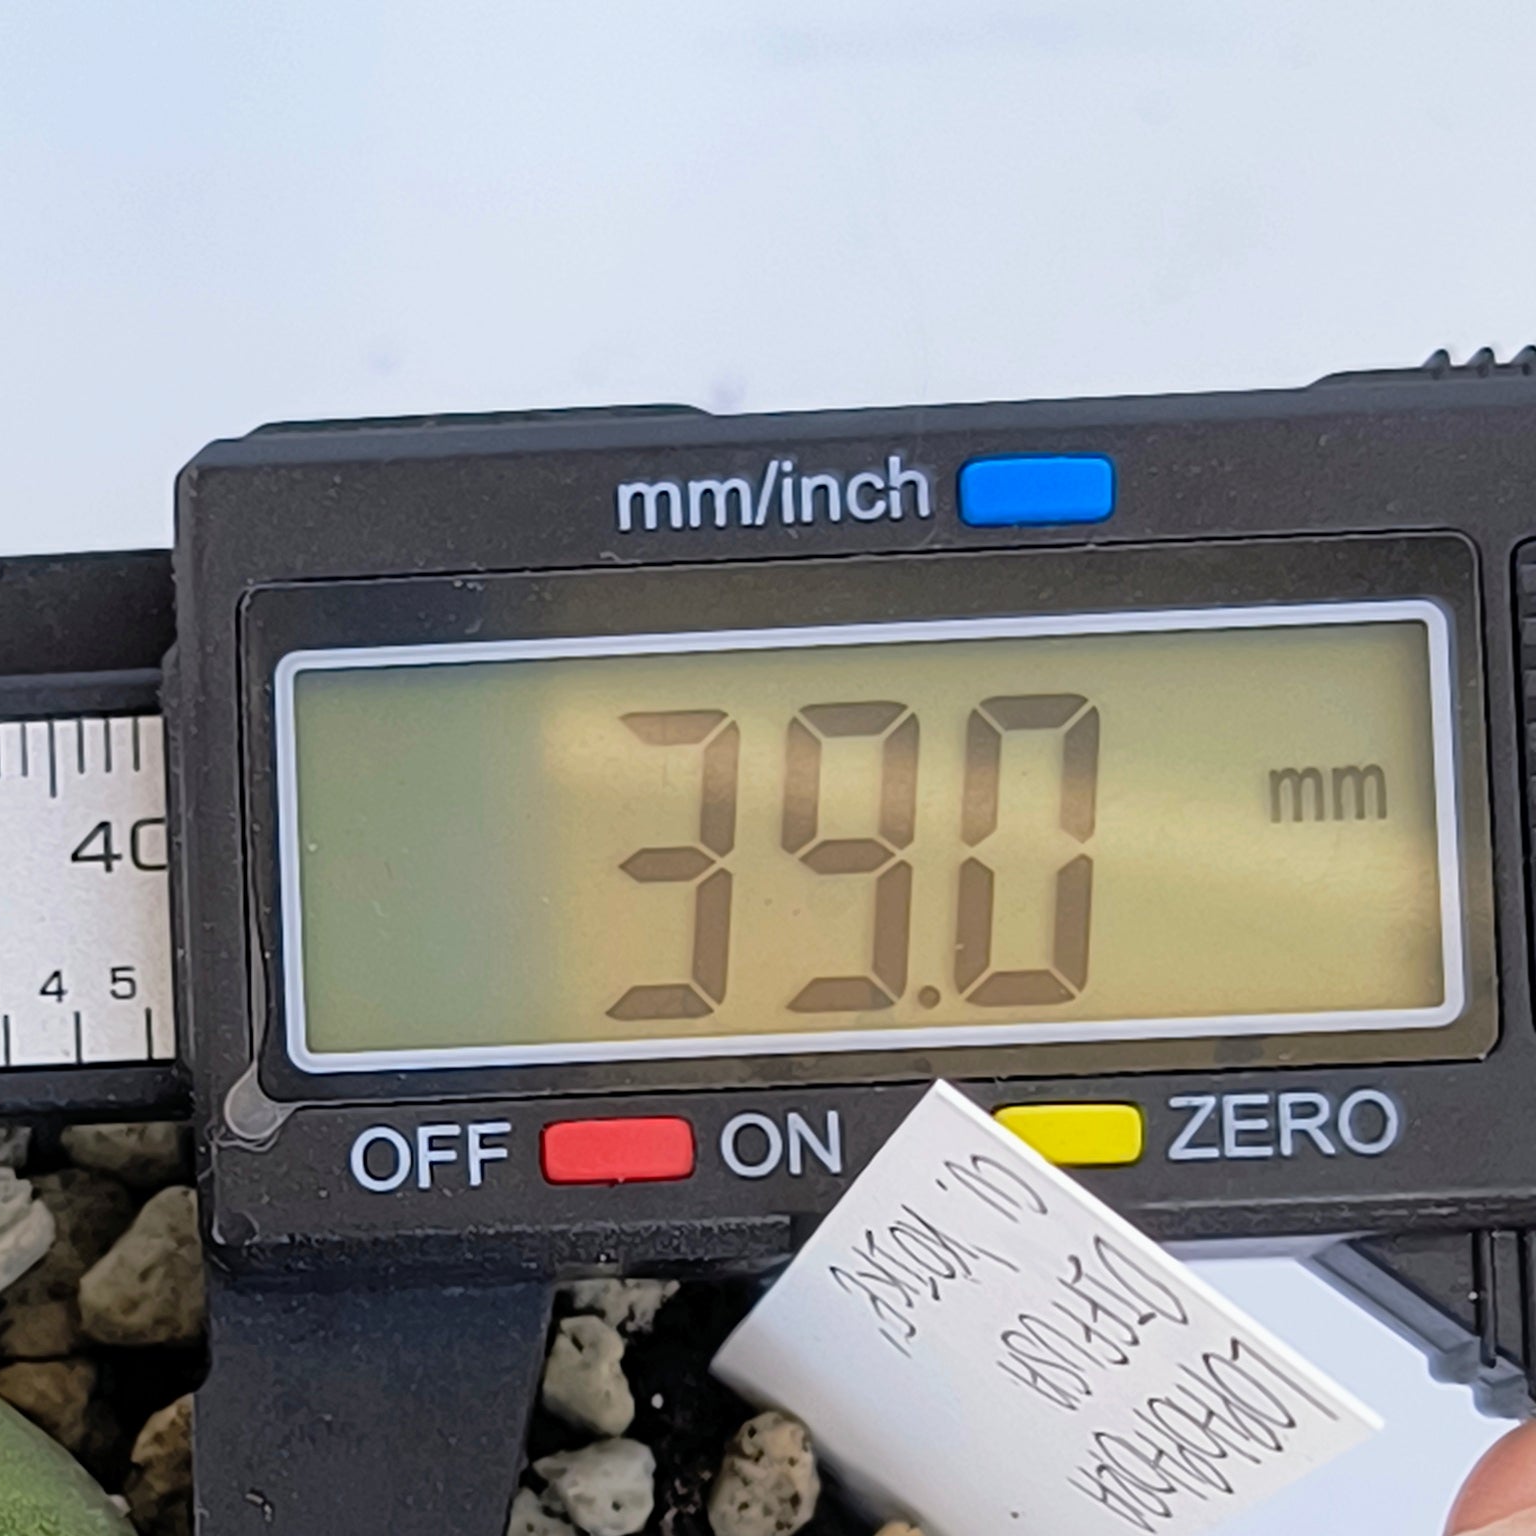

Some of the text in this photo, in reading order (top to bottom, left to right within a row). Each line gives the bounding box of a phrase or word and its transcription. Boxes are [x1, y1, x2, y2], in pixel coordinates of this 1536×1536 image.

[616, 457, 932, 534] mm/inch
[605, 691, 1389, 1022] 39.0 mm
[39, 969, 68, 1004] 4
[109, 966, 137, 1001] 5
[349, 1089, 1402, 1193] OFF ON ZERO
[997, 1234, 1189, 1412] DIFFUSA
[1068, 1336, 1340, 1534] LOPHOPHORA
